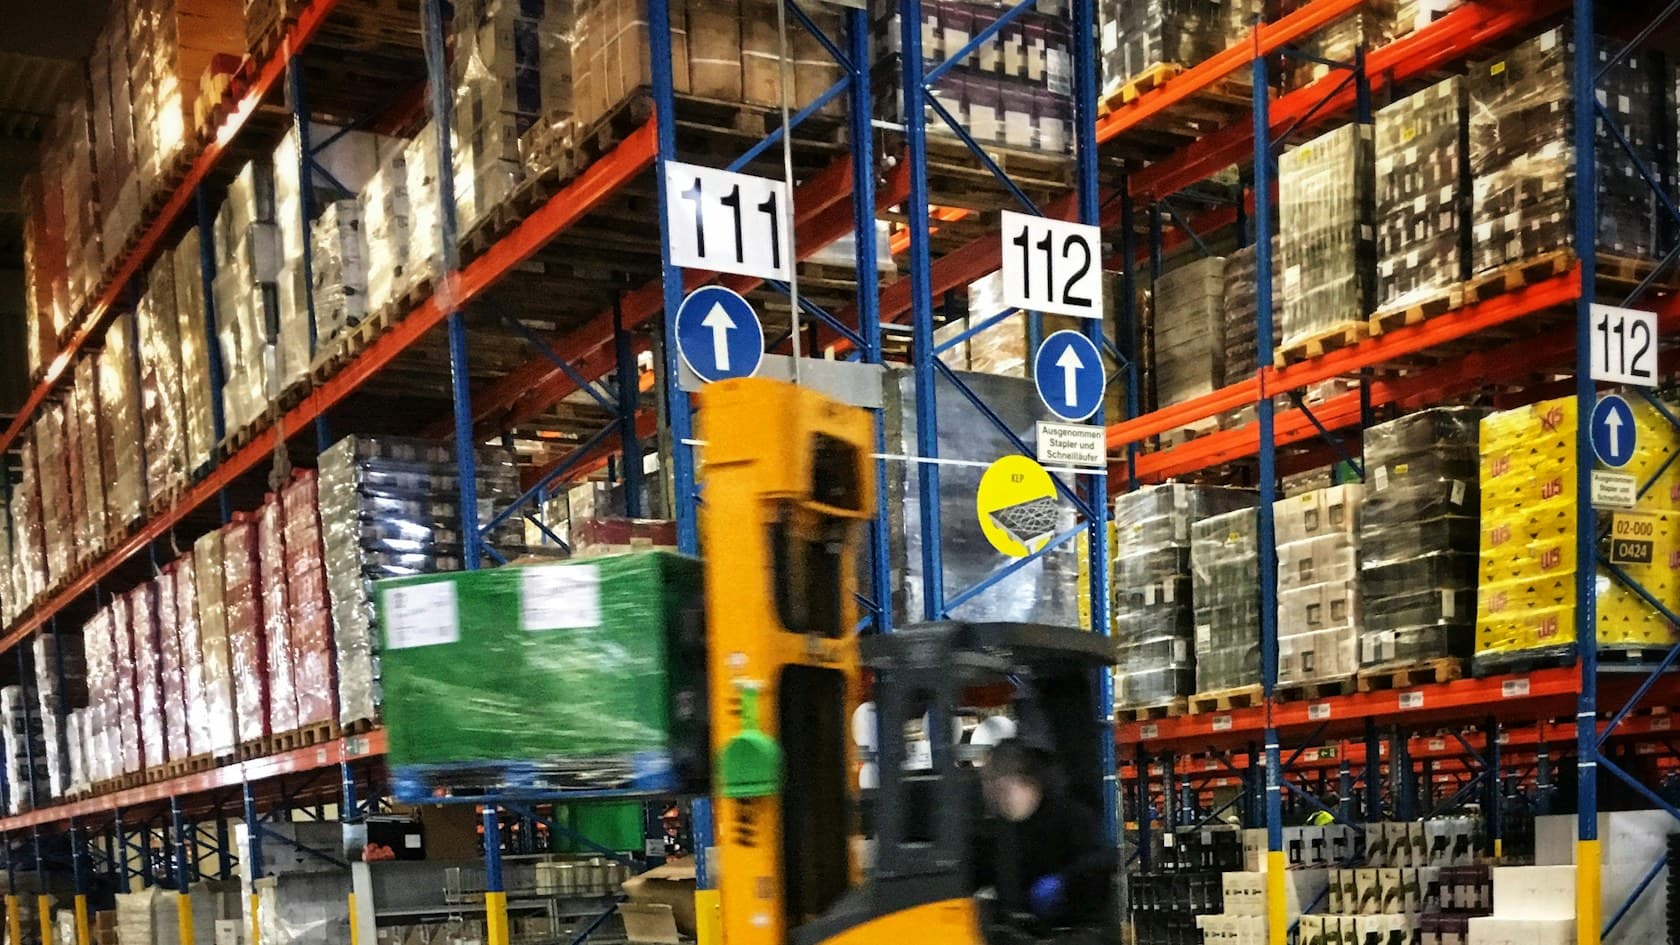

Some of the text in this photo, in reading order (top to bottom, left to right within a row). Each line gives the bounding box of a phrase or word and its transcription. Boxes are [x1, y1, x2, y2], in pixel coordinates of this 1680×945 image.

[681, 177, 781, 270] 111
[1012, 225, 1093, 308] 112
[1597, 314, 1651, 378] 112
[1042, 426, 1101, 439] Ausgenommen
[1049, 438, 1095, 450] Stapler und
[1010, 473, 1025, 483] KEP
